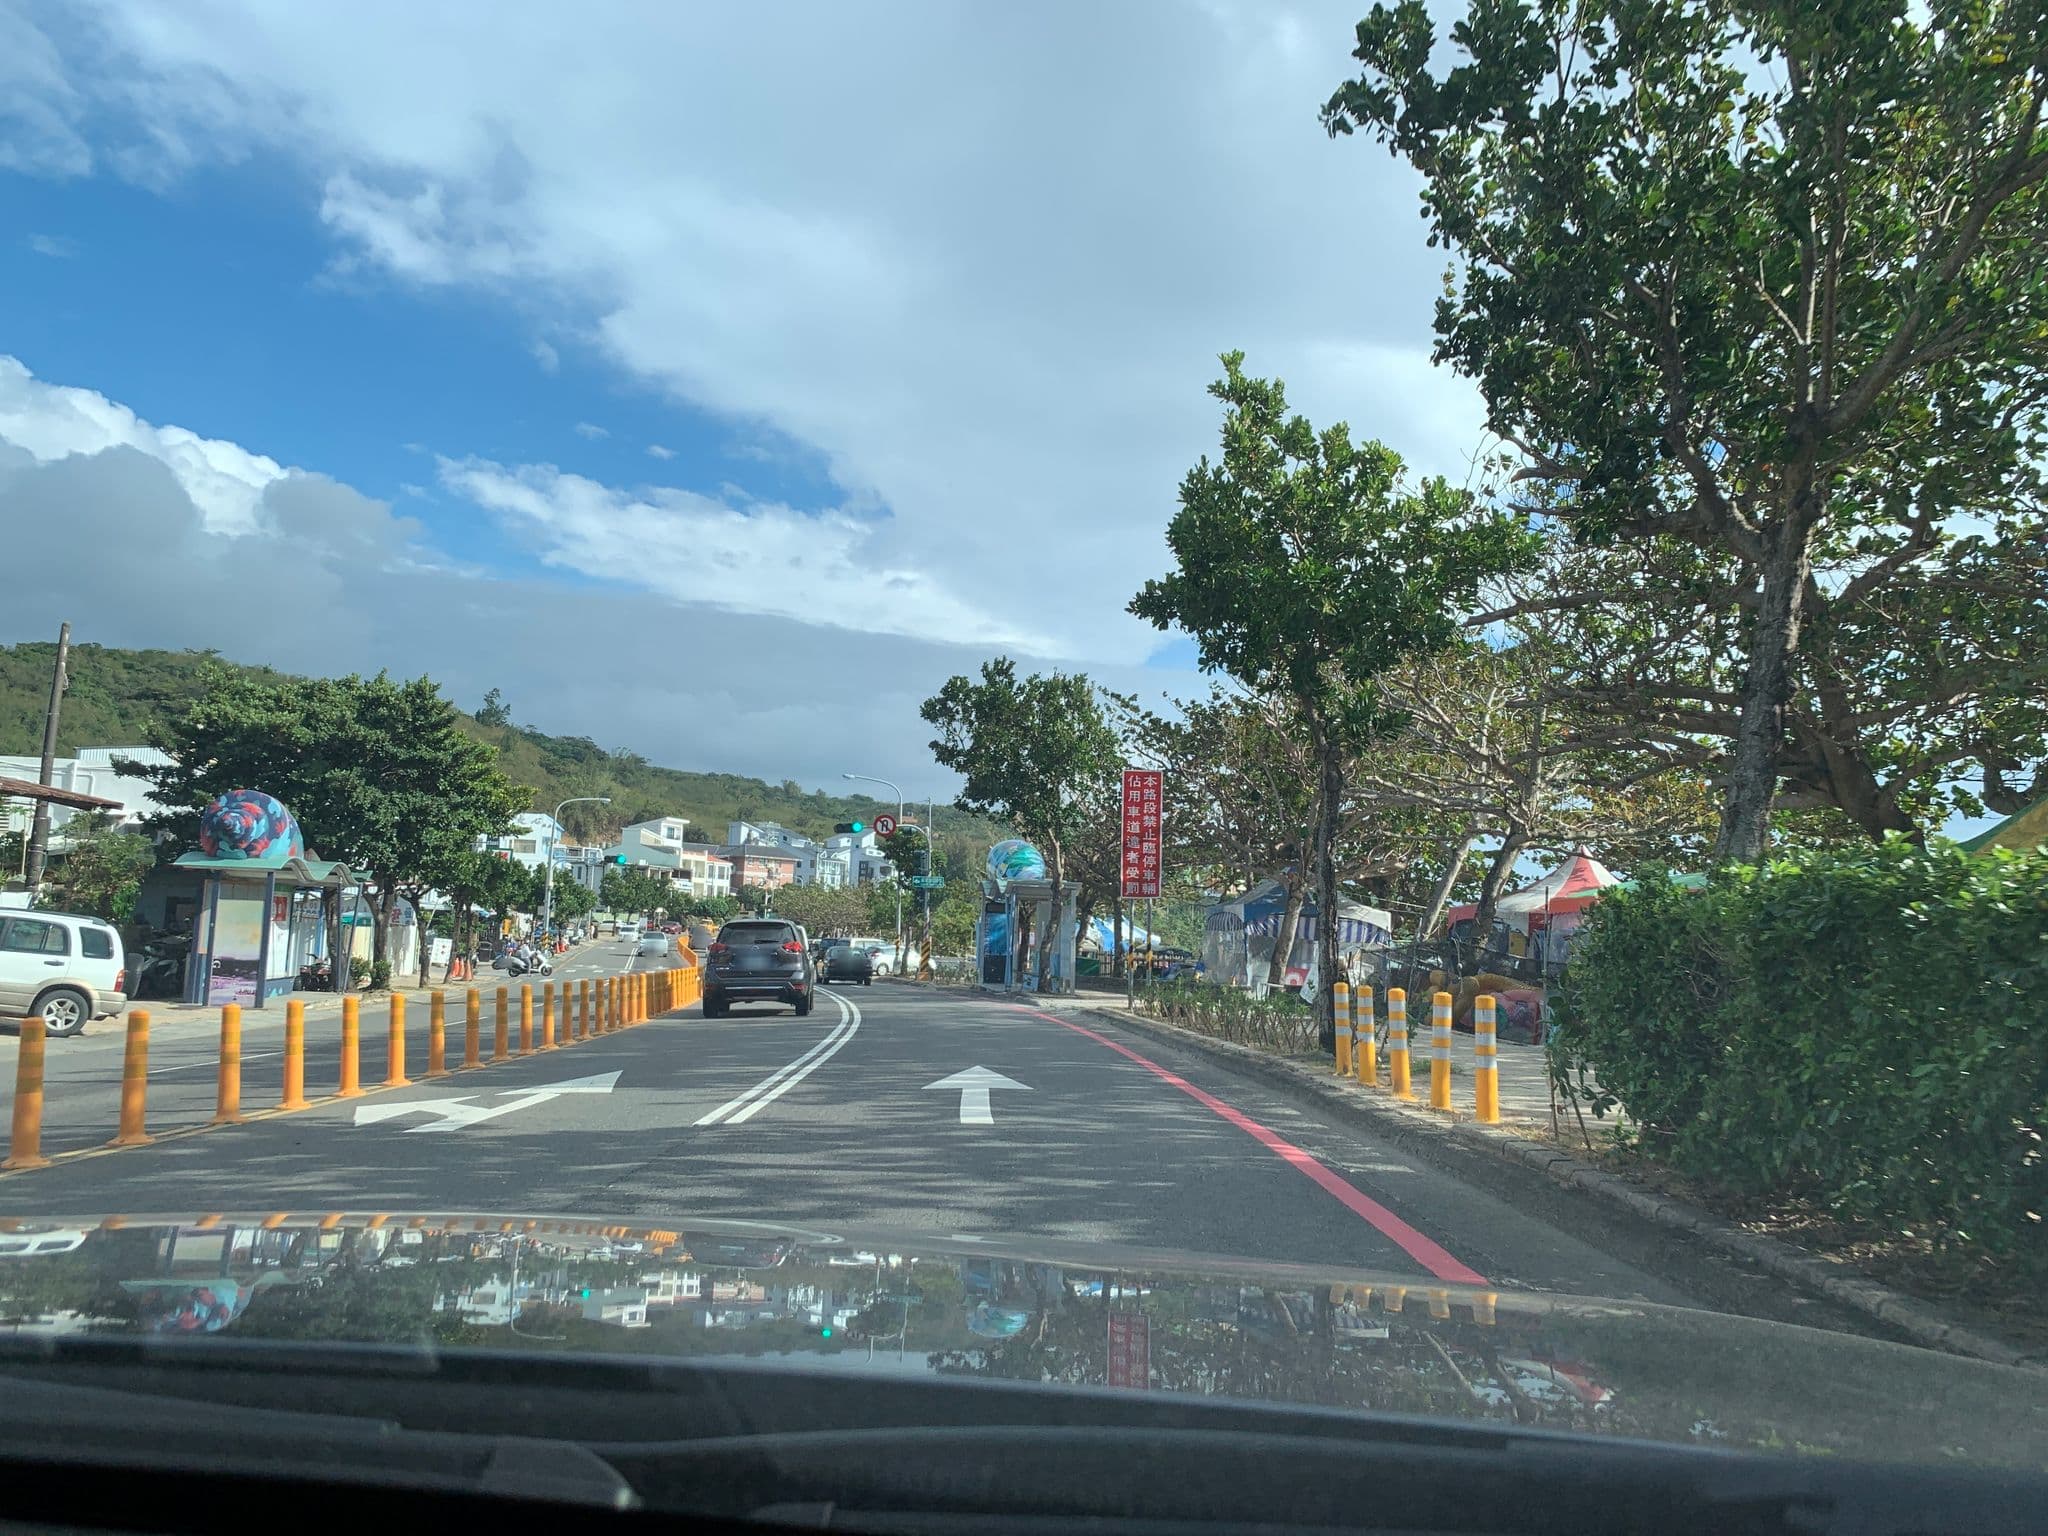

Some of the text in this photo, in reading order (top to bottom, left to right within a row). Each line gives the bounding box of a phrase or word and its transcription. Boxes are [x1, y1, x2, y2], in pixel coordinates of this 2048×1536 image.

[1142, 775, 1157, 895] 本路段禁止臨停車輛
